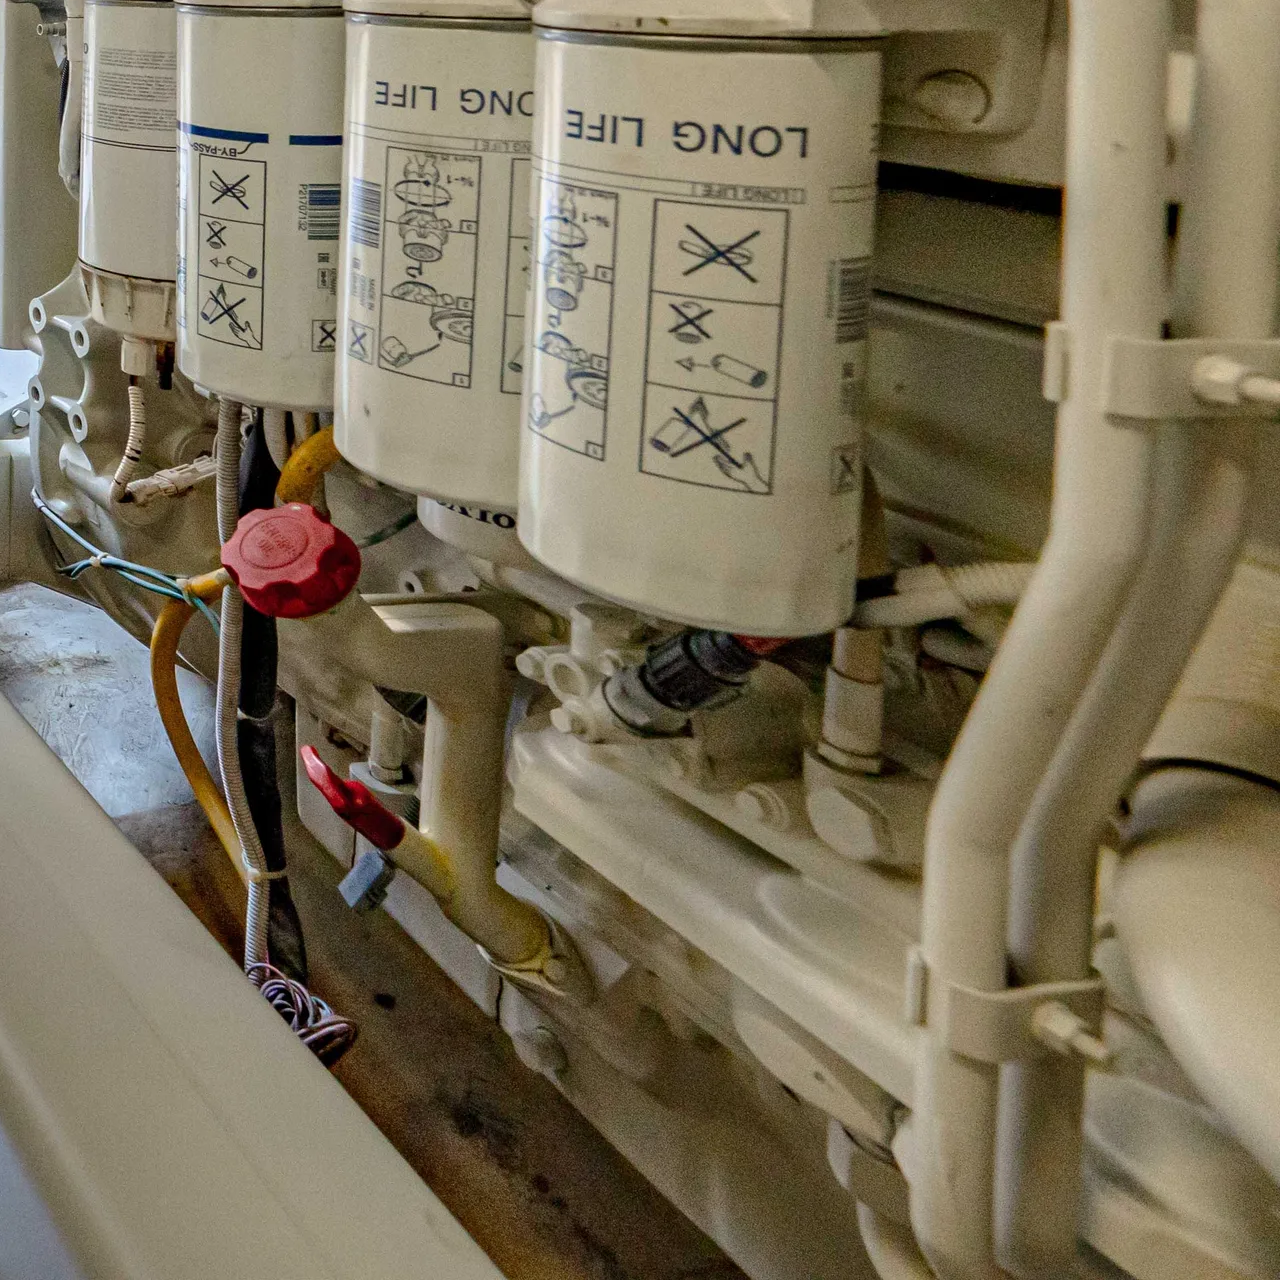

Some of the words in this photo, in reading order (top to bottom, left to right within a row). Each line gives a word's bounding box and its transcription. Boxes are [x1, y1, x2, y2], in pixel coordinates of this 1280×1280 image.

[374, 80, 437, 111] LIFE
[460, 88, 534, 116] ONG
[566, 109, 644, 147] LIFE
[673, 120, 808, 158] LONG
[194, 142, 237, 157] BY-PASS
[298, 183, 308, 231] P21707132
